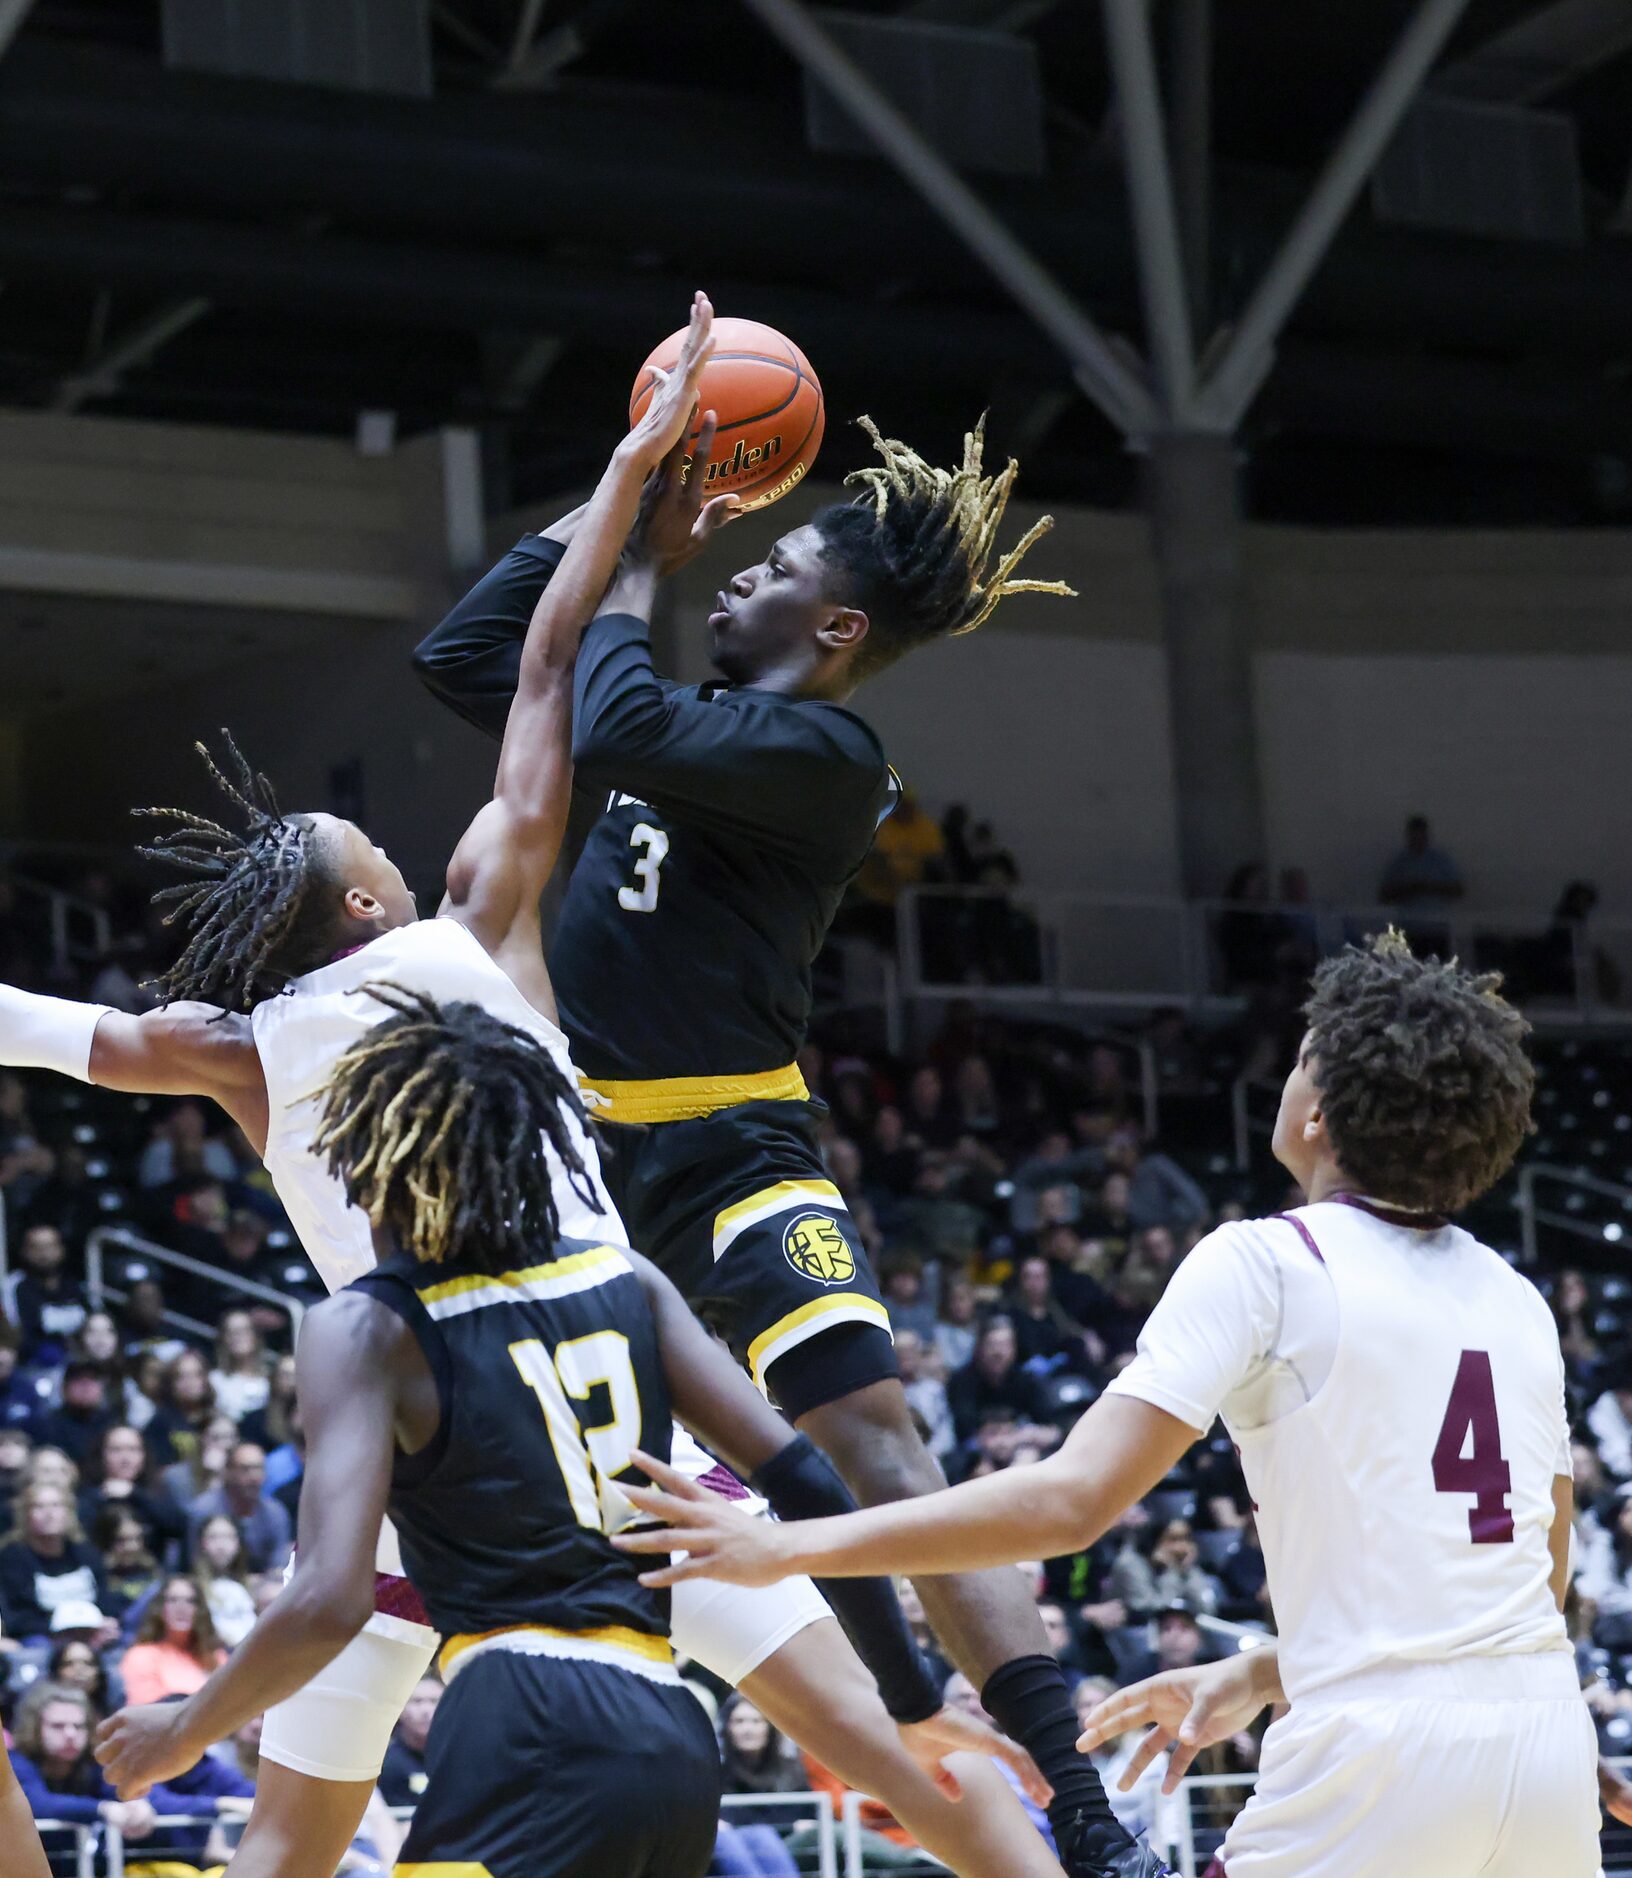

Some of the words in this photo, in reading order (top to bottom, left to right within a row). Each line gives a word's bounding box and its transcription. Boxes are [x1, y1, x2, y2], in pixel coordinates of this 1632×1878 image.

[768, 463, 805, 499] PRO
[618, 822, 670, 913] 3
[508, 1329, 664, 1537] 12
[1431, 1349, 1515, 1543] 4
